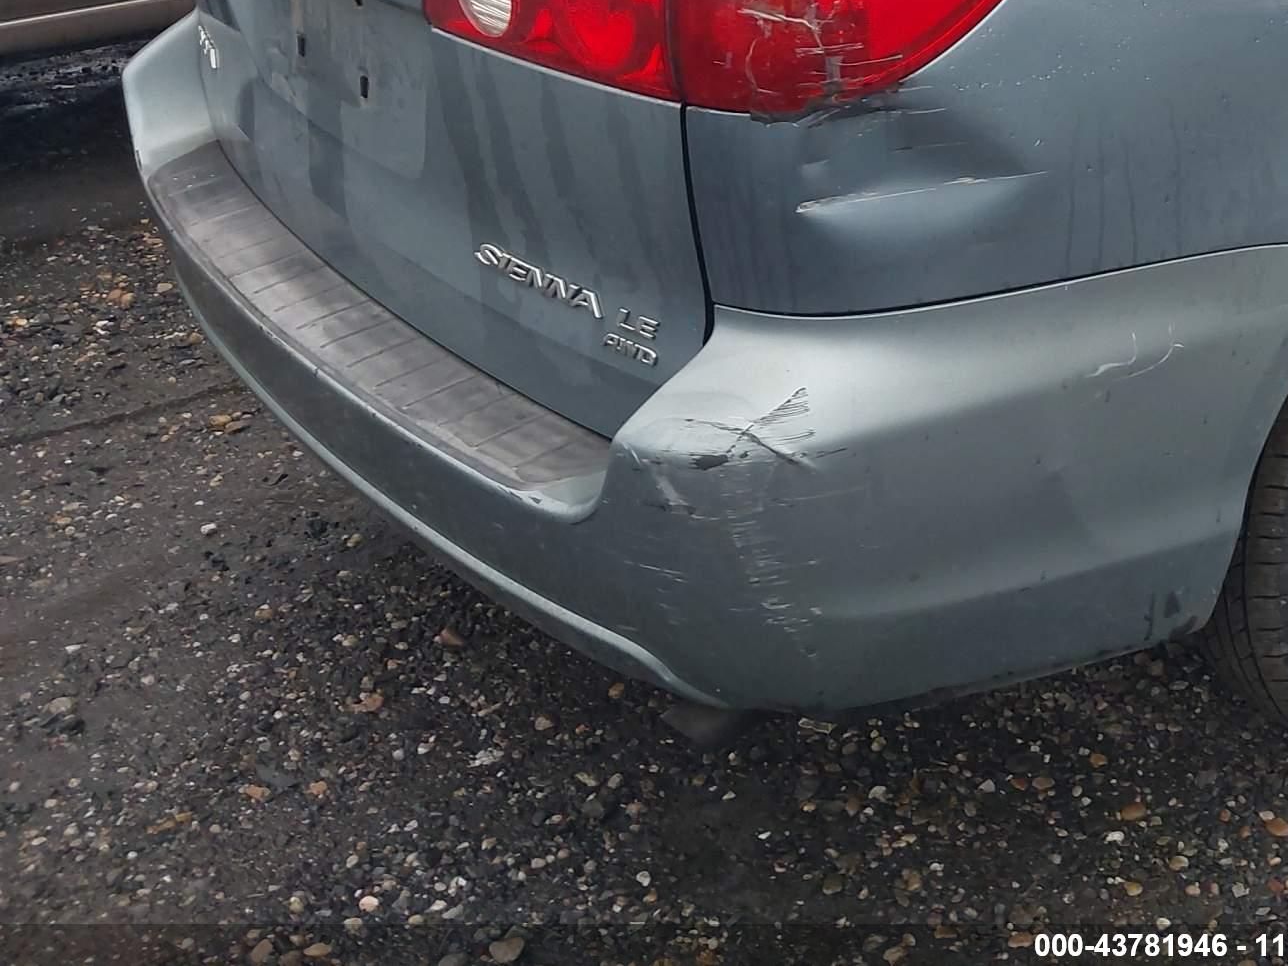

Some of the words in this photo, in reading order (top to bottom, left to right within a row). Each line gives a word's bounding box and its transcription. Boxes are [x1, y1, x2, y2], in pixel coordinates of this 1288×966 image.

[474, 243, 604, 319] SIENNA
[616, 307, 660, 340] LE
[601, 333, 658, 367] AWD
